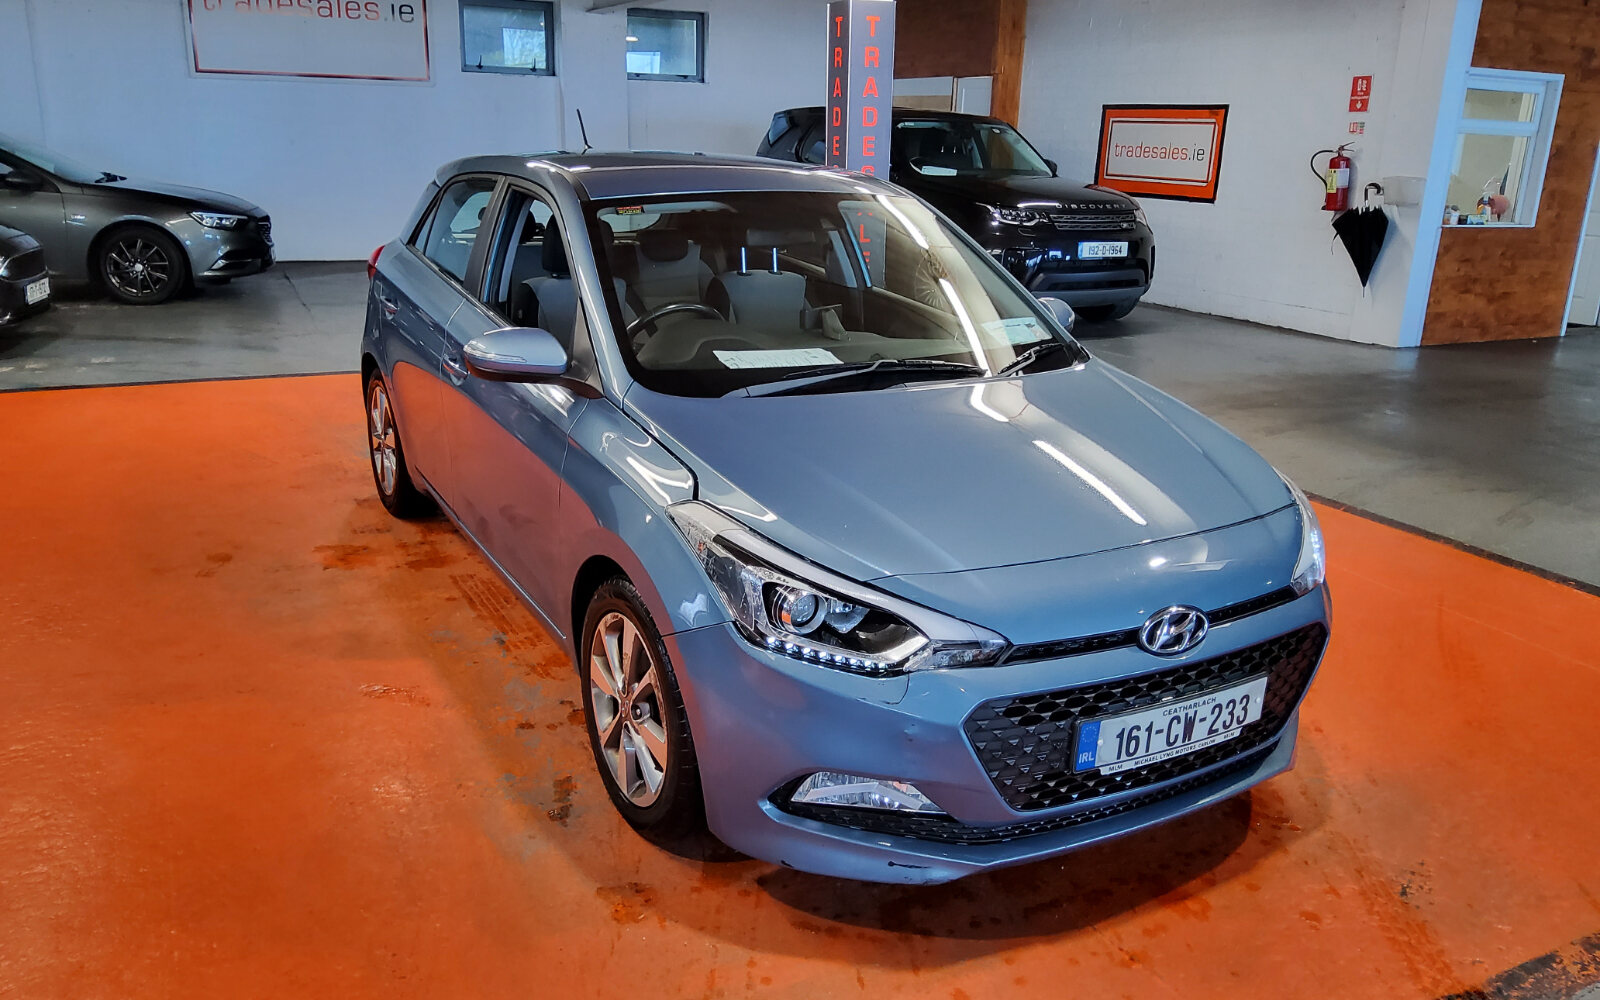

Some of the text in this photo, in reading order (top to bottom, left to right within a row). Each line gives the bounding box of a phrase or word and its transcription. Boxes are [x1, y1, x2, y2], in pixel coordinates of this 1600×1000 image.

[832, 16, 844, 168] TRADE
[1114, 141, 1205, 161] tradesales.ie
[1088, 245, 1123, 255] 192-D-1964
[1162, 697, 1217, 717] CEATHARLACH
[1115, 694, 1250, 760] 161-CW-233
[1078, 751, 1095, 764] IRL
[1134, 755, 1159, 766] MICHAEL
[1174, 745, 1196, 755] MOTORS
